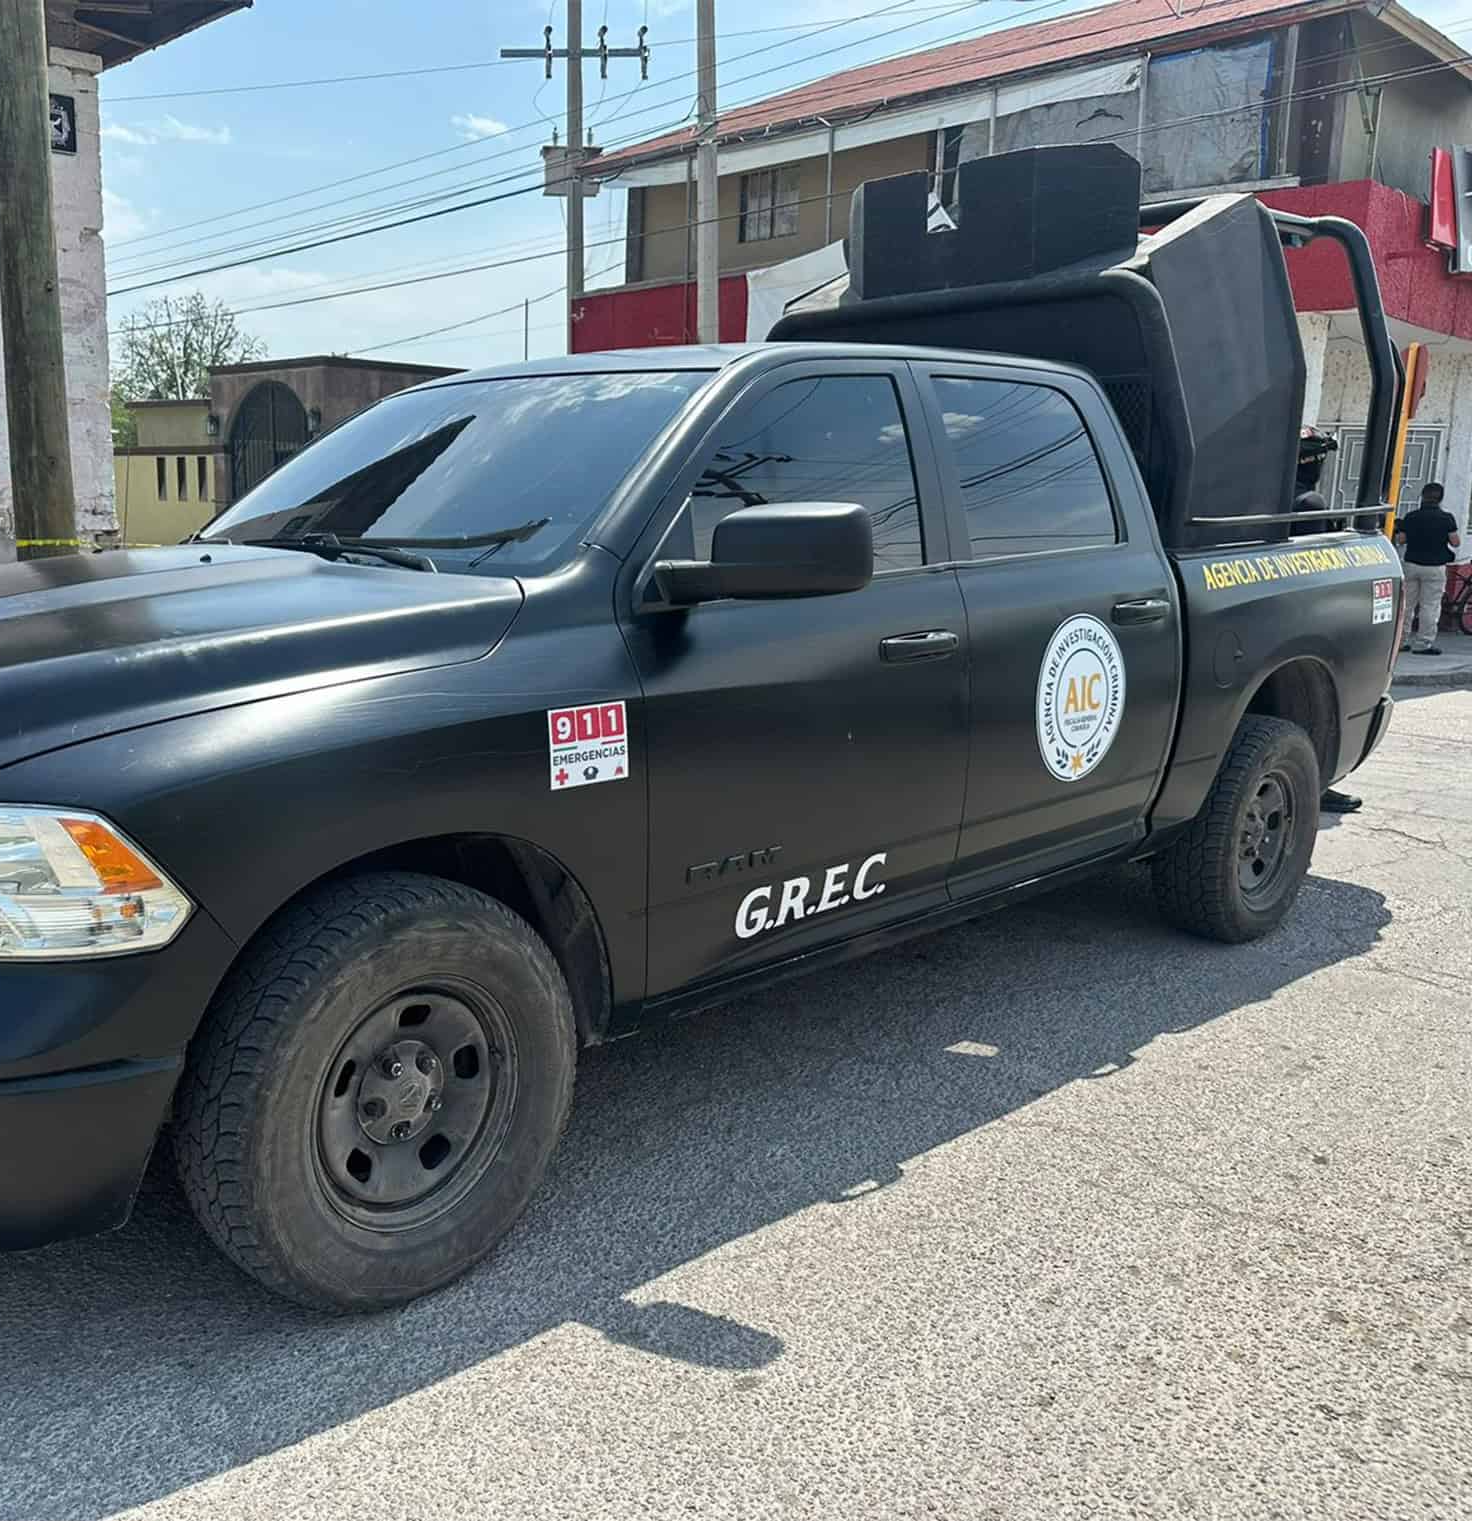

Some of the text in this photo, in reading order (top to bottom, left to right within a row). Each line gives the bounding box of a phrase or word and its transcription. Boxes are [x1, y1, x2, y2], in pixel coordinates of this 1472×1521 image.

[1202, 559, 1262, 591] AGENCIA
[1257, 557, 1279, 580] DE
[1049, 658, 1060, 678] DE
[1064, 673, 1102, 713] AIC
[1103, 664, 1120, 732] CRIMINAL
[556, 709, 618, 740] 911
[1044, 681, 1056, 744] AGENCIA
[553, 745, 626, 766] EMERGENCIAS
[735, 852, 887, 938] G.R.E.C.
